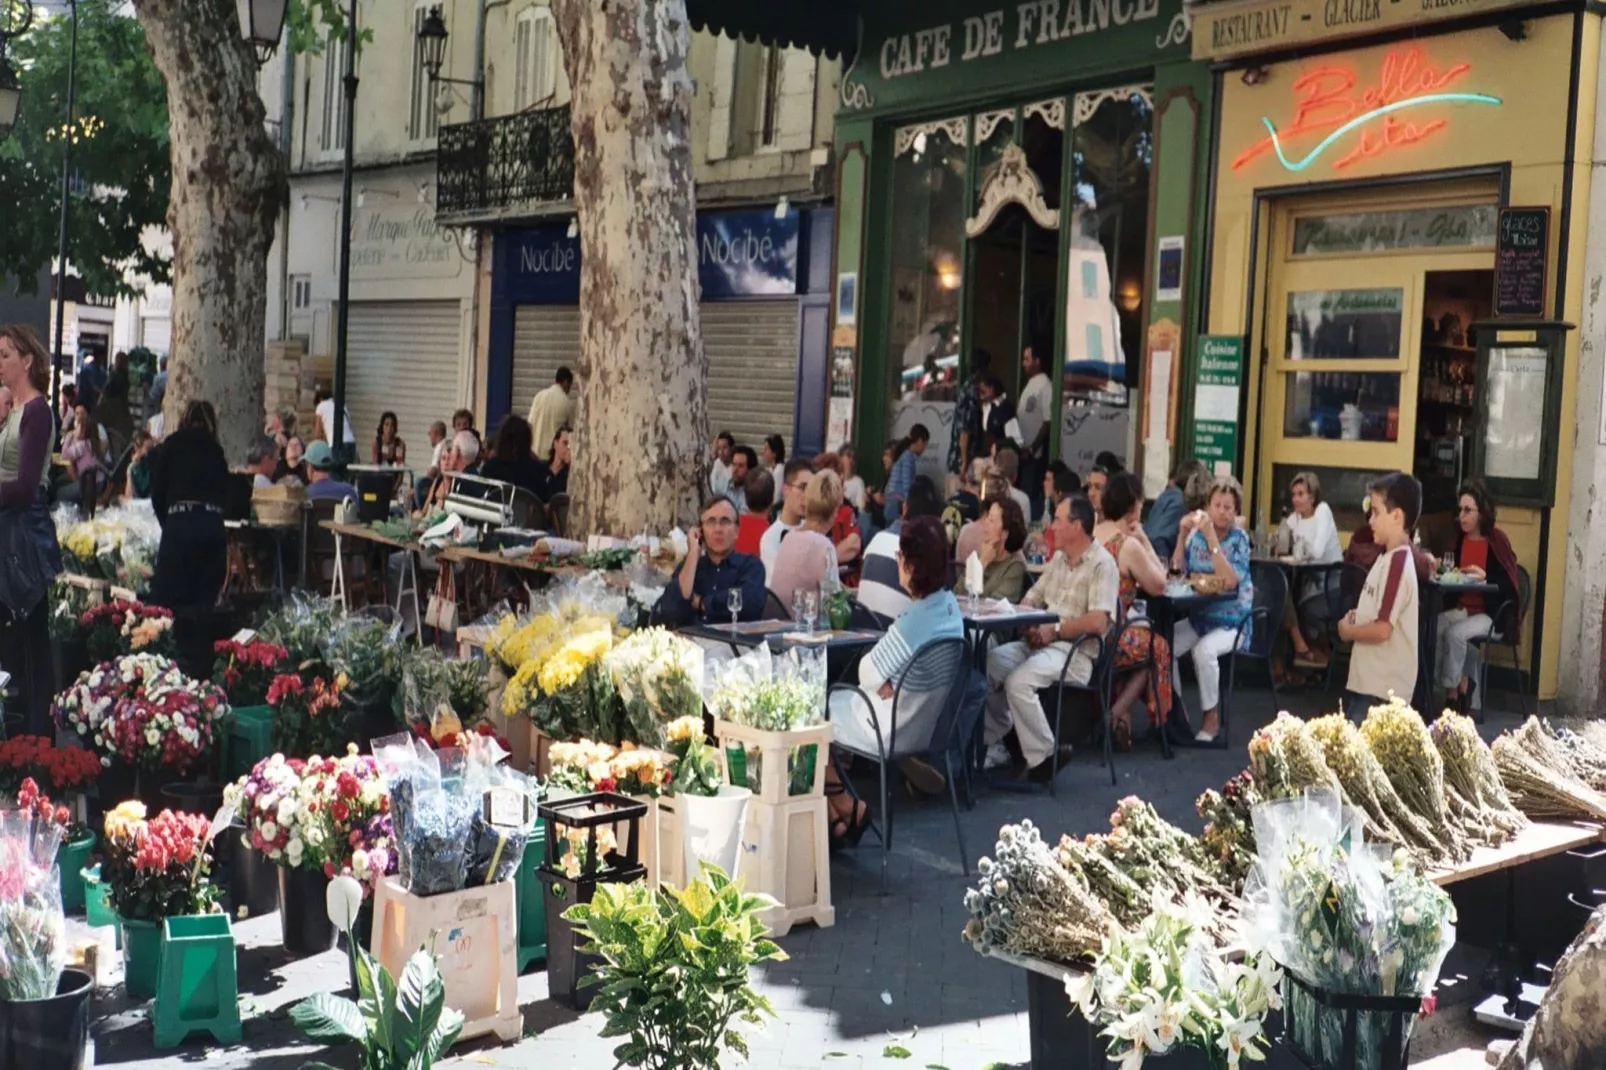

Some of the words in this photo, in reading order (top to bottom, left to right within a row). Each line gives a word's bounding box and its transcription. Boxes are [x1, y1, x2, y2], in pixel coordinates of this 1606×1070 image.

[880, 24, 951, 79] CAFE
[961, 11, 1004, 61] DE
[1212, 6, 1291, 49] RESTAURANT
[1324, 0, 1382, 28] GLACIER
[1245, 45, 1470, 150] Bella
[521, 241, 575, 273] Nocibé
[702, 227, 773, 265] Nocibé
[1204, 341, 1238, 356] Cuisine
